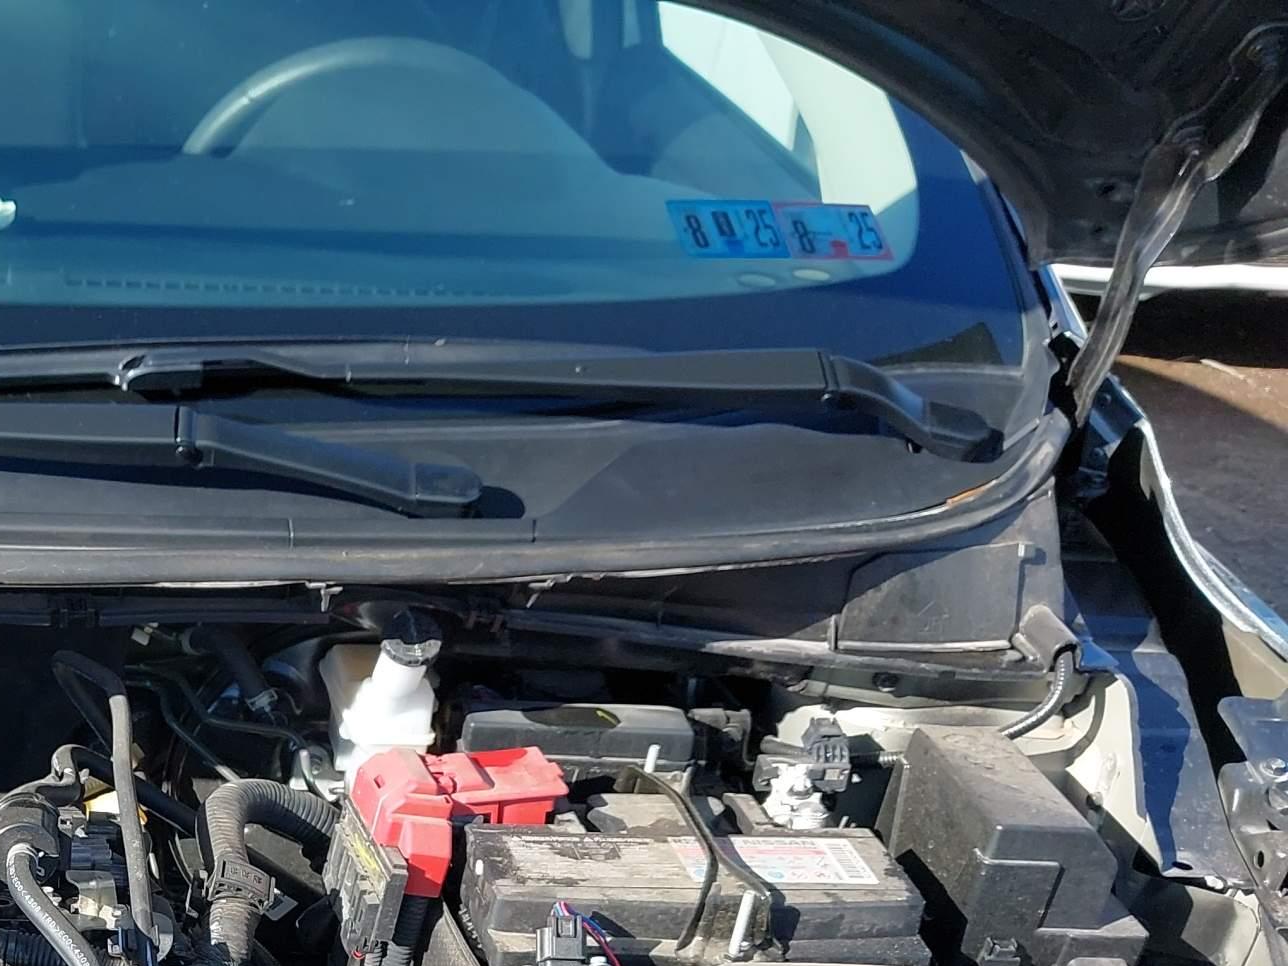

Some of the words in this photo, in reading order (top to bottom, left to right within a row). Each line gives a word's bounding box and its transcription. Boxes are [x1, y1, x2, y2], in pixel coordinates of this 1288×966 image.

[684, 214, 710, 249] 8
[745, 209, 780, 248] 25
[791, 219, 817, 254] 8
[848, 211, 884, 251] 25
